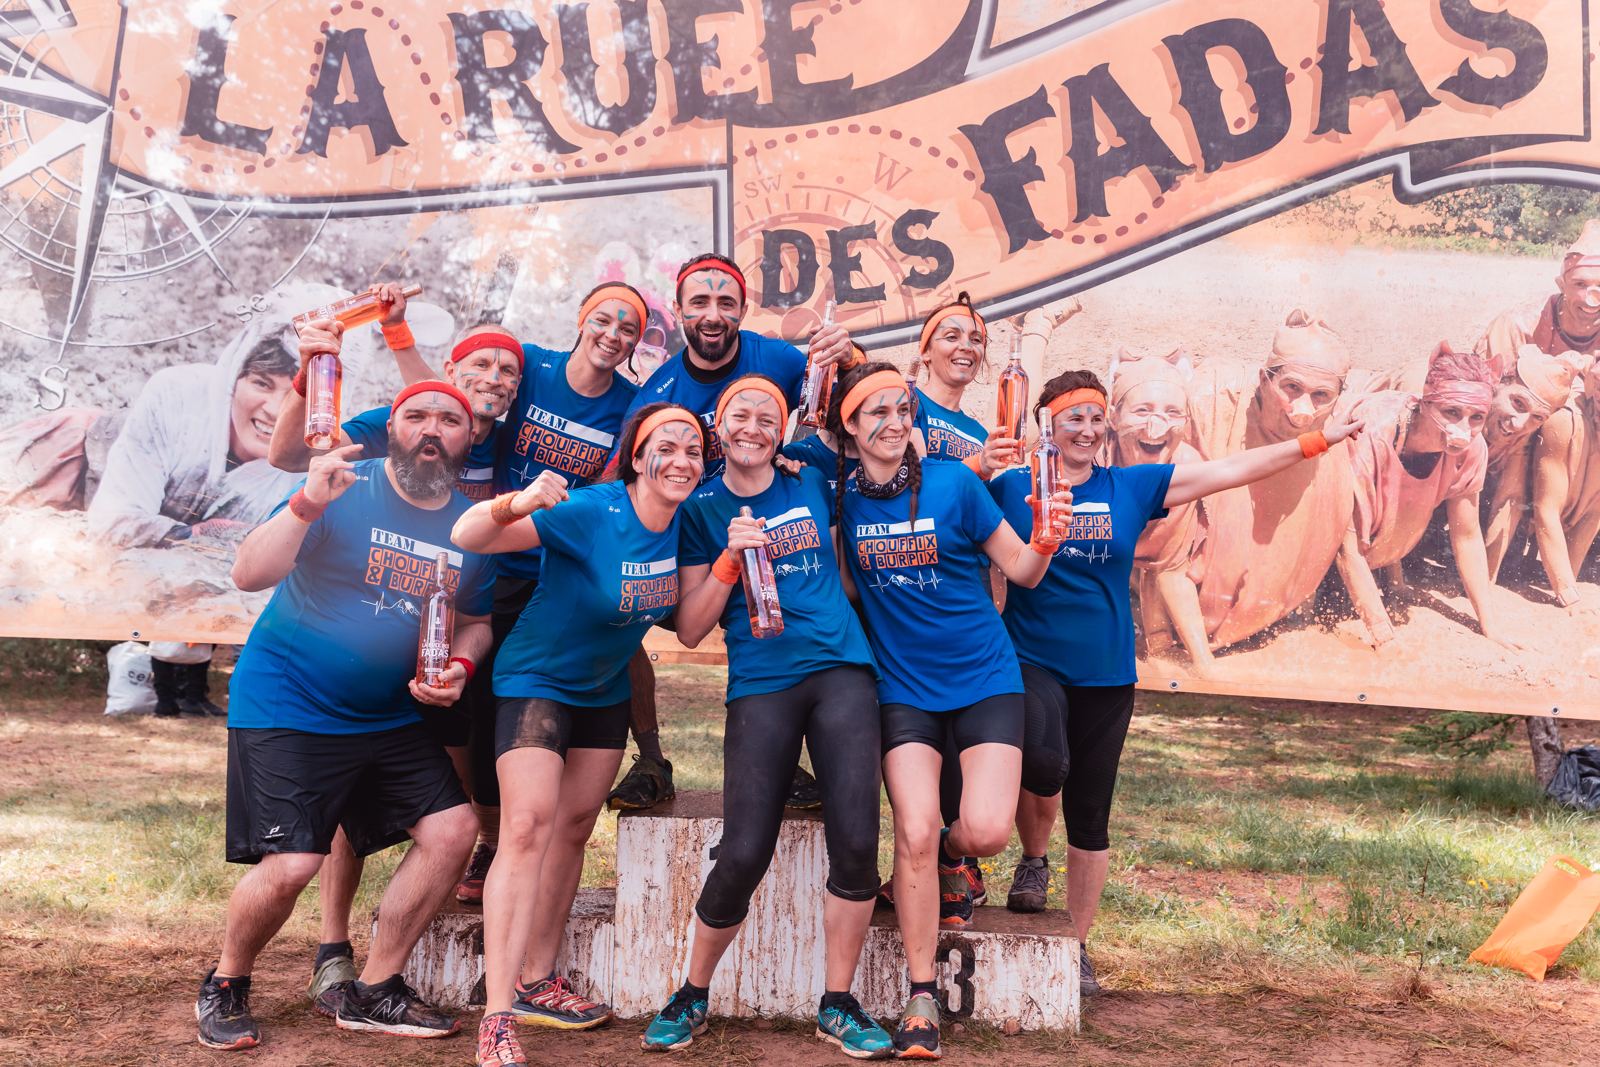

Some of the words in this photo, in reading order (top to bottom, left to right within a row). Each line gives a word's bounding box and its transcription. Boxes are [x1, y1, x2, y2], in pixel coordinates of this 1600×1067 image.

[180, 14, 410, 158] LA
[957, 0, 1548, 255] FADAS
[761, 208, 955, 309] DES
[530, 406, 568, 431] TEAM
[516, 437, 527, 454] &
[520, 423, 609, 464] CHOUFFIX
[769, 520, 817, 542] UFFIX
[858, 524, 890, 536] TEAM
[1066, 528, 1111, 539] URPIX
[373, 528, 416, 553] TEAM
[770, 533, 820, 557] URPIX
[858, 535, 936, 554] CHOUFFIX
[623, 562, 651, 575] TEAM
[860, 555, 870, 569] &
[876, 551, 937, 567] BURPIX
[367, 565, 381, 583] &
[621, 596, 632, 611] &
[421, 648, 449, 658] FADAS
[935, 936, 976, 1018] 3
